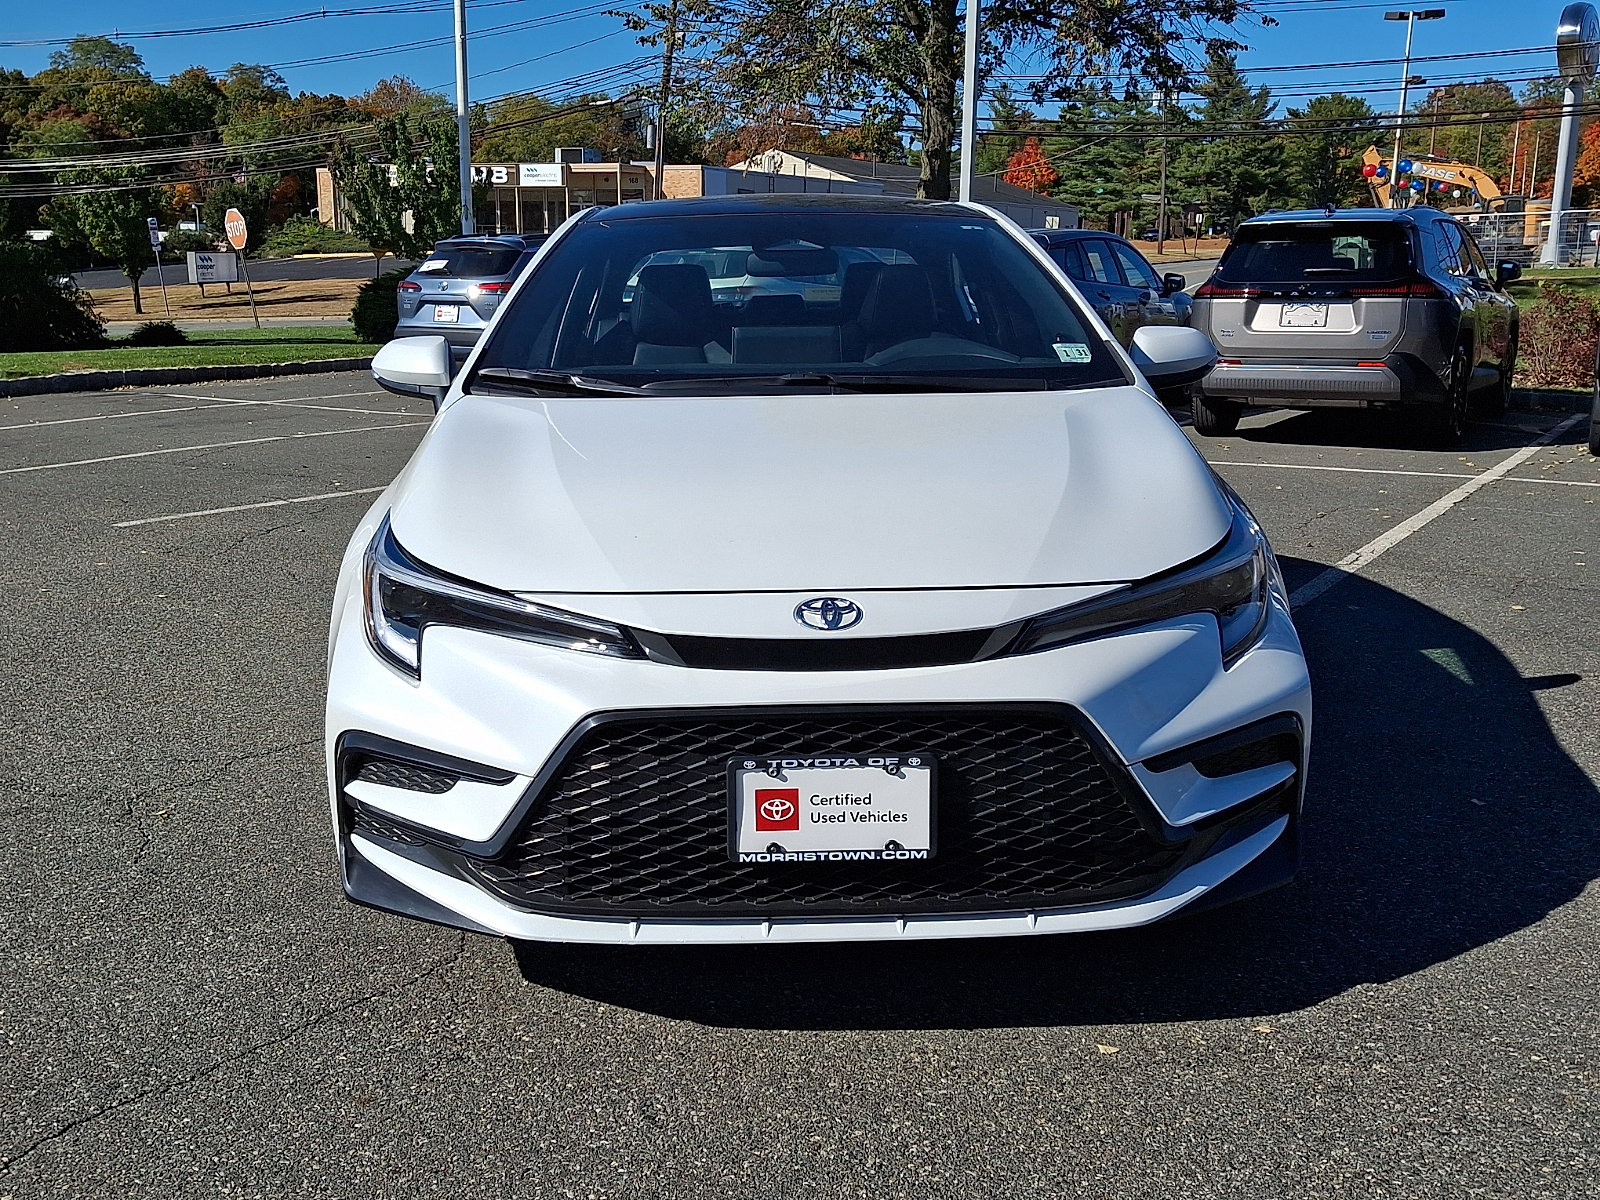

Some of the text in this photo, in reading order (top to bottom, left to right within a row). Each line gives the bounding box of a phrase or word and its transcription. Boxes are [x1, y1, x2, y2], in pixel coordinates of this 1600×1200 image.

[226, 220, 244, 238] STOP
[197, 263, 215, 271] cooper
[1062, 348, 1089, 358] 1 31
[767, 757, 900, 768] TOYOTA OF
[810, 793, 872, 806] Certified
[810, 810, 908, 824] Used Vehicles
[739, 849, 928, 863] MORRISTOWN.COM
